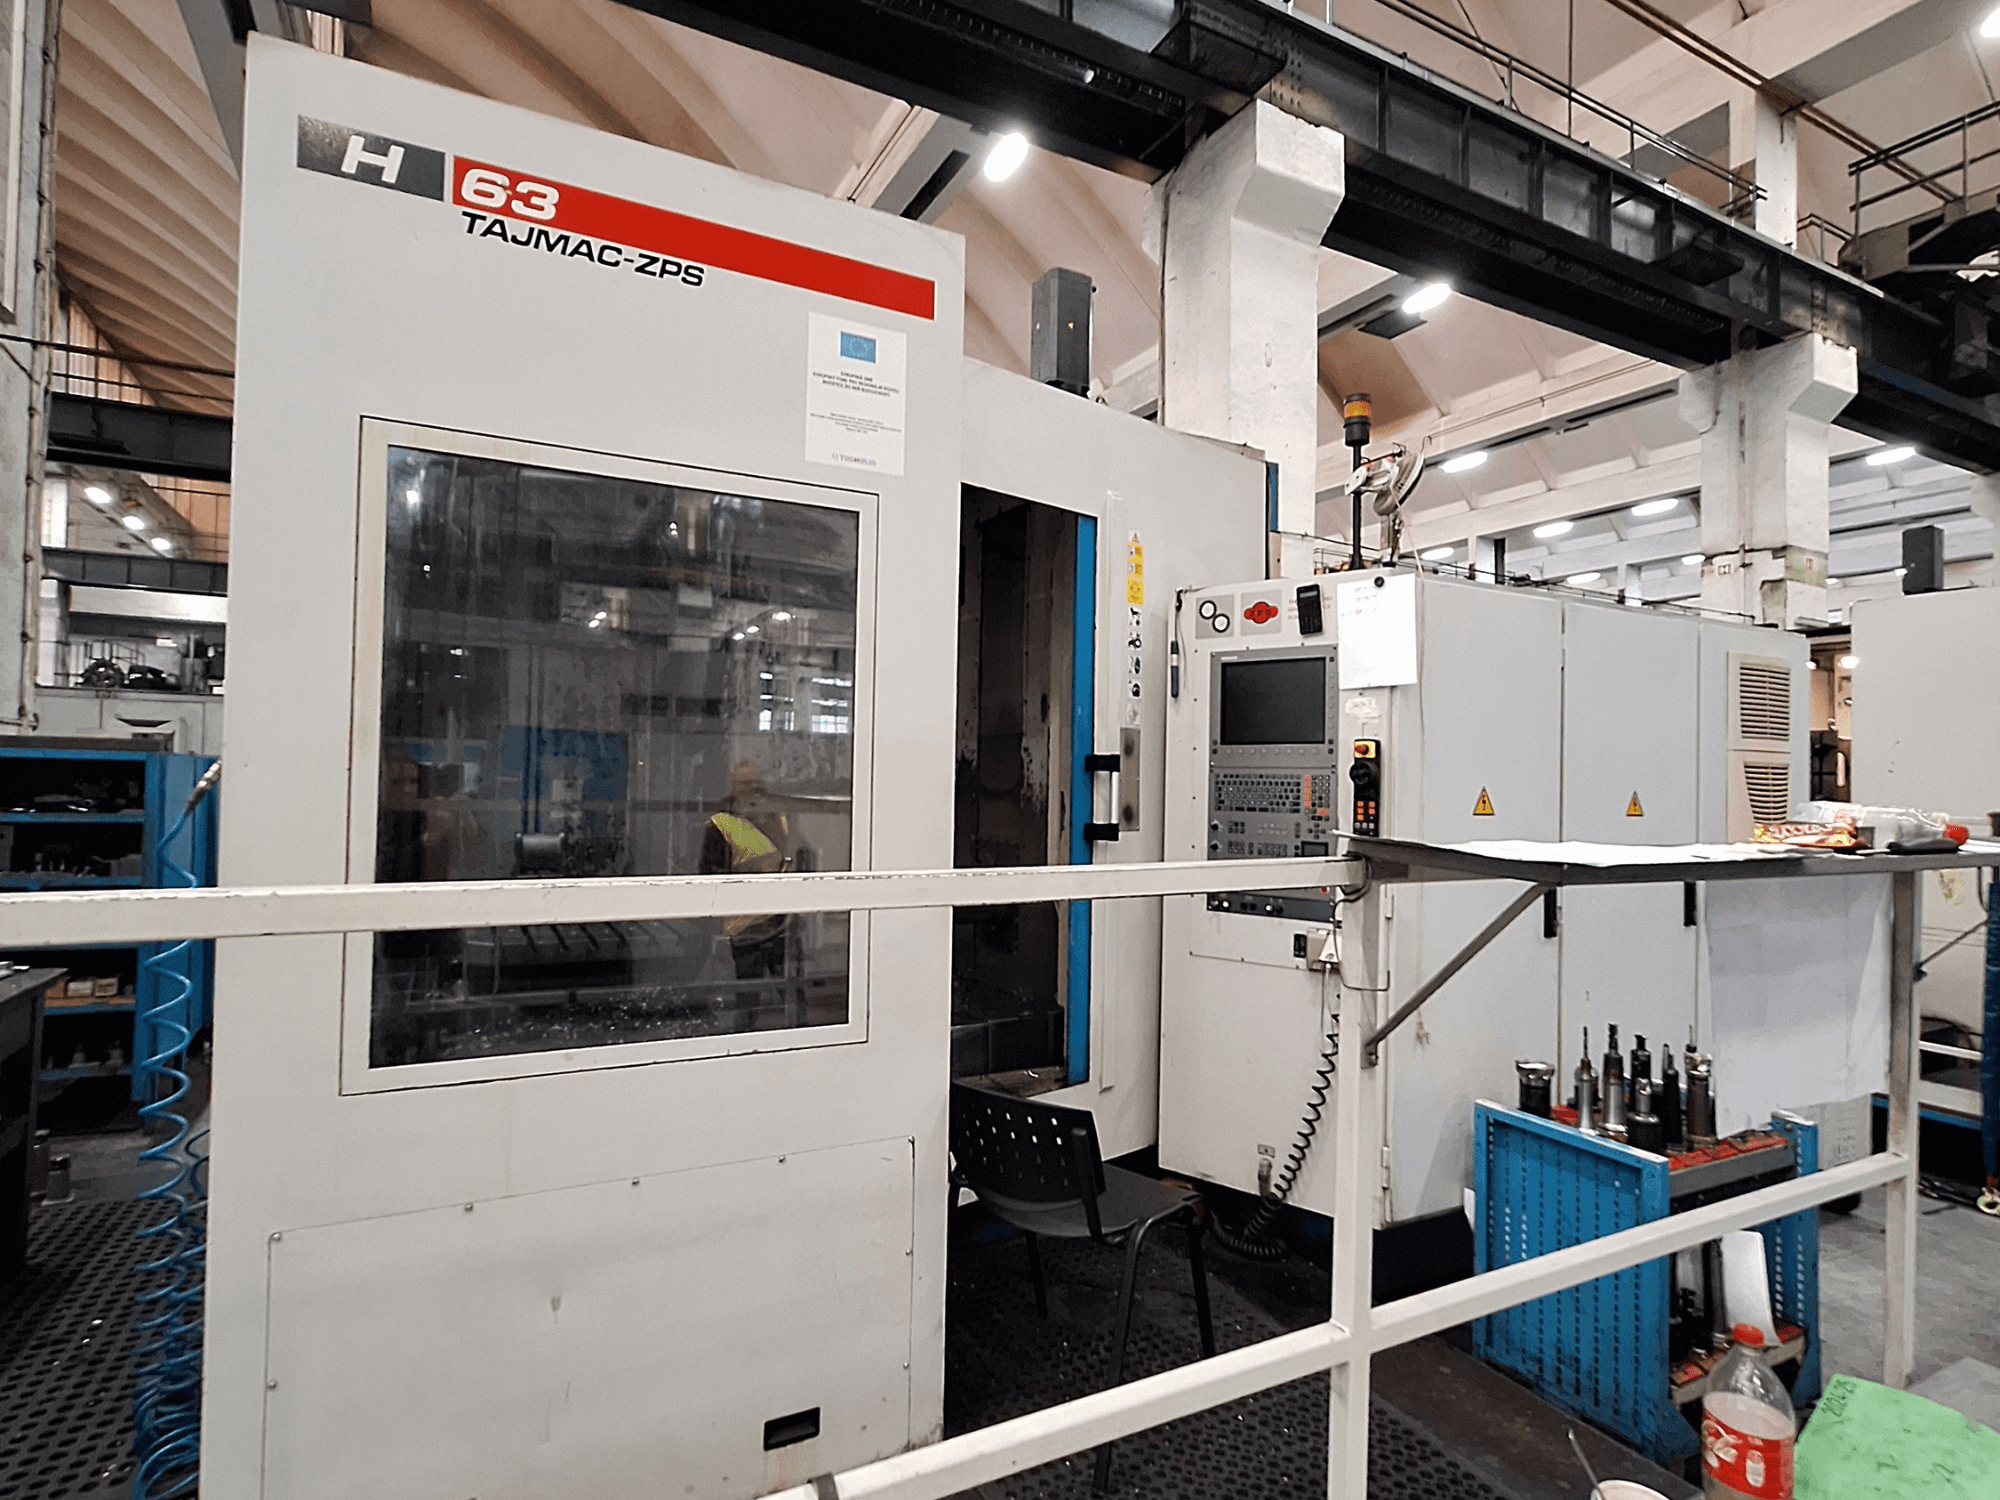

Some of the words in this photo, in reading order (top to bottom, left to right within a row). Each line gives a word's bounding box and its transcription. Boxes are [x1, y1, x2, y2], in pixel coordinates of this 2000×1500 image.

[340, 135, 405, 184] H
[460, 168, 560, 222] 63
[461, 210, 705, 287] TAJMAC-ZPS
